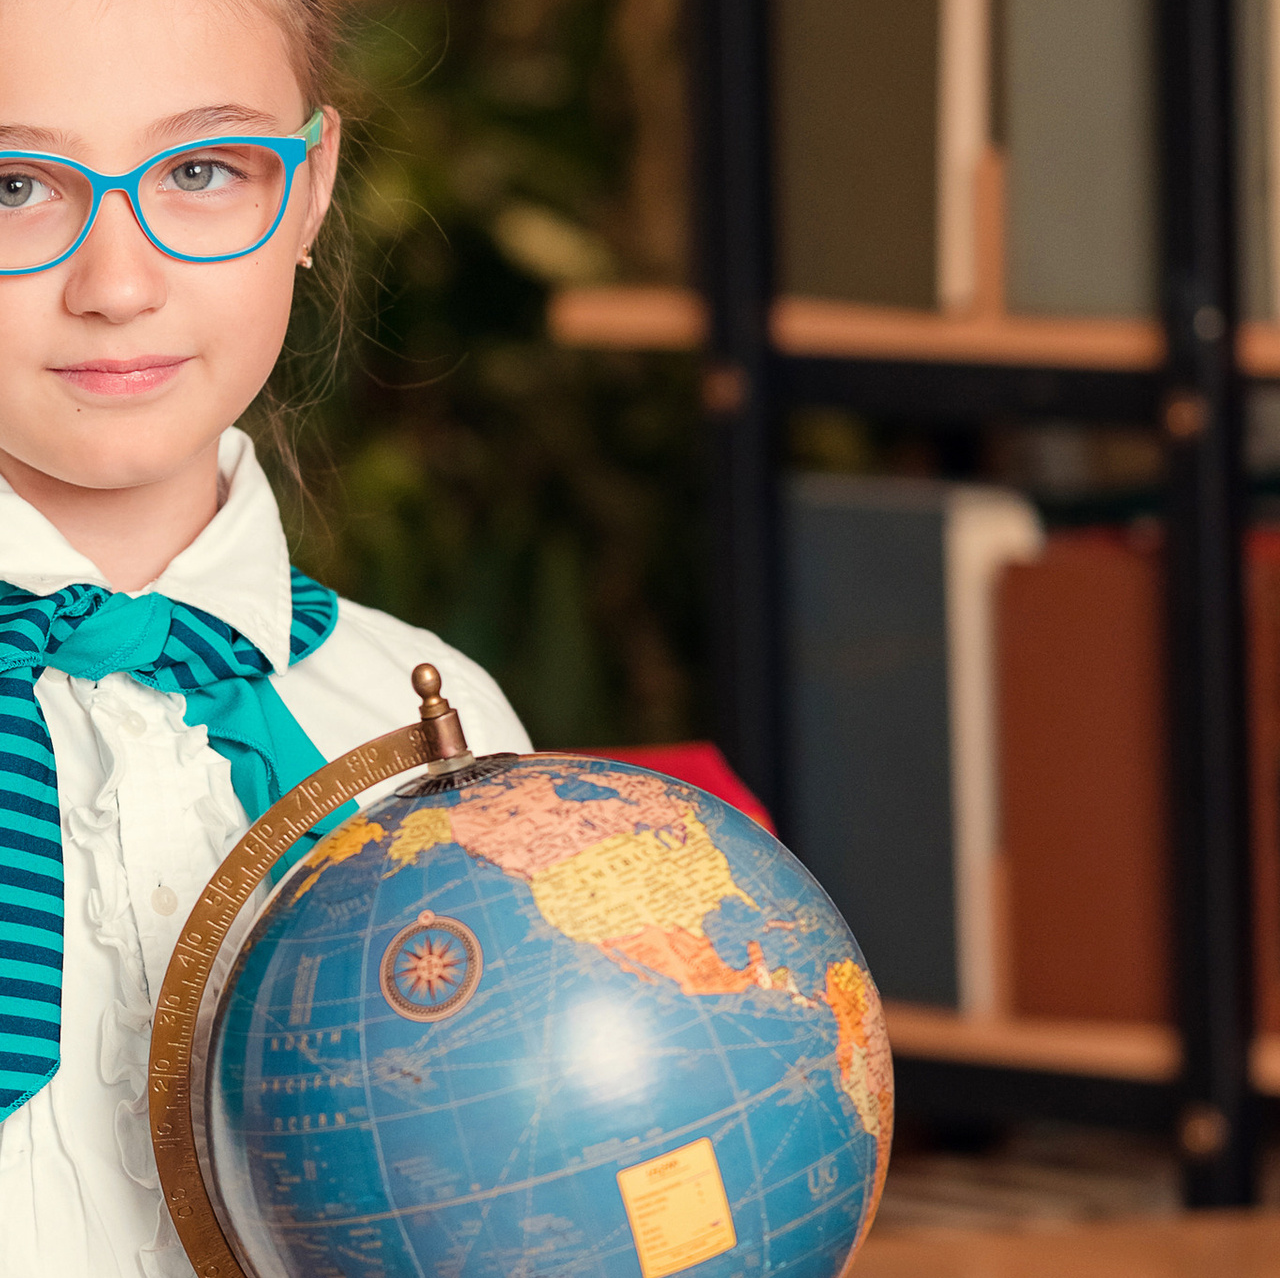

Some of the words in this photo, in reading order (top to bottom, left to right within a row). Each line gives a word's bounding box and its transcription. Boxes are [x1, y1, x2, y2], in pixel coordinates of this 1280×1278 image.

[294, 780, 323, 810] 70
[243, 823, 274, 855] 60
[205, 875, 233, 907] 50
[177, 932, 202, 968] 40
[160, 994, 180, 1026] 30
[153, 1058, 171, 1093] 20
